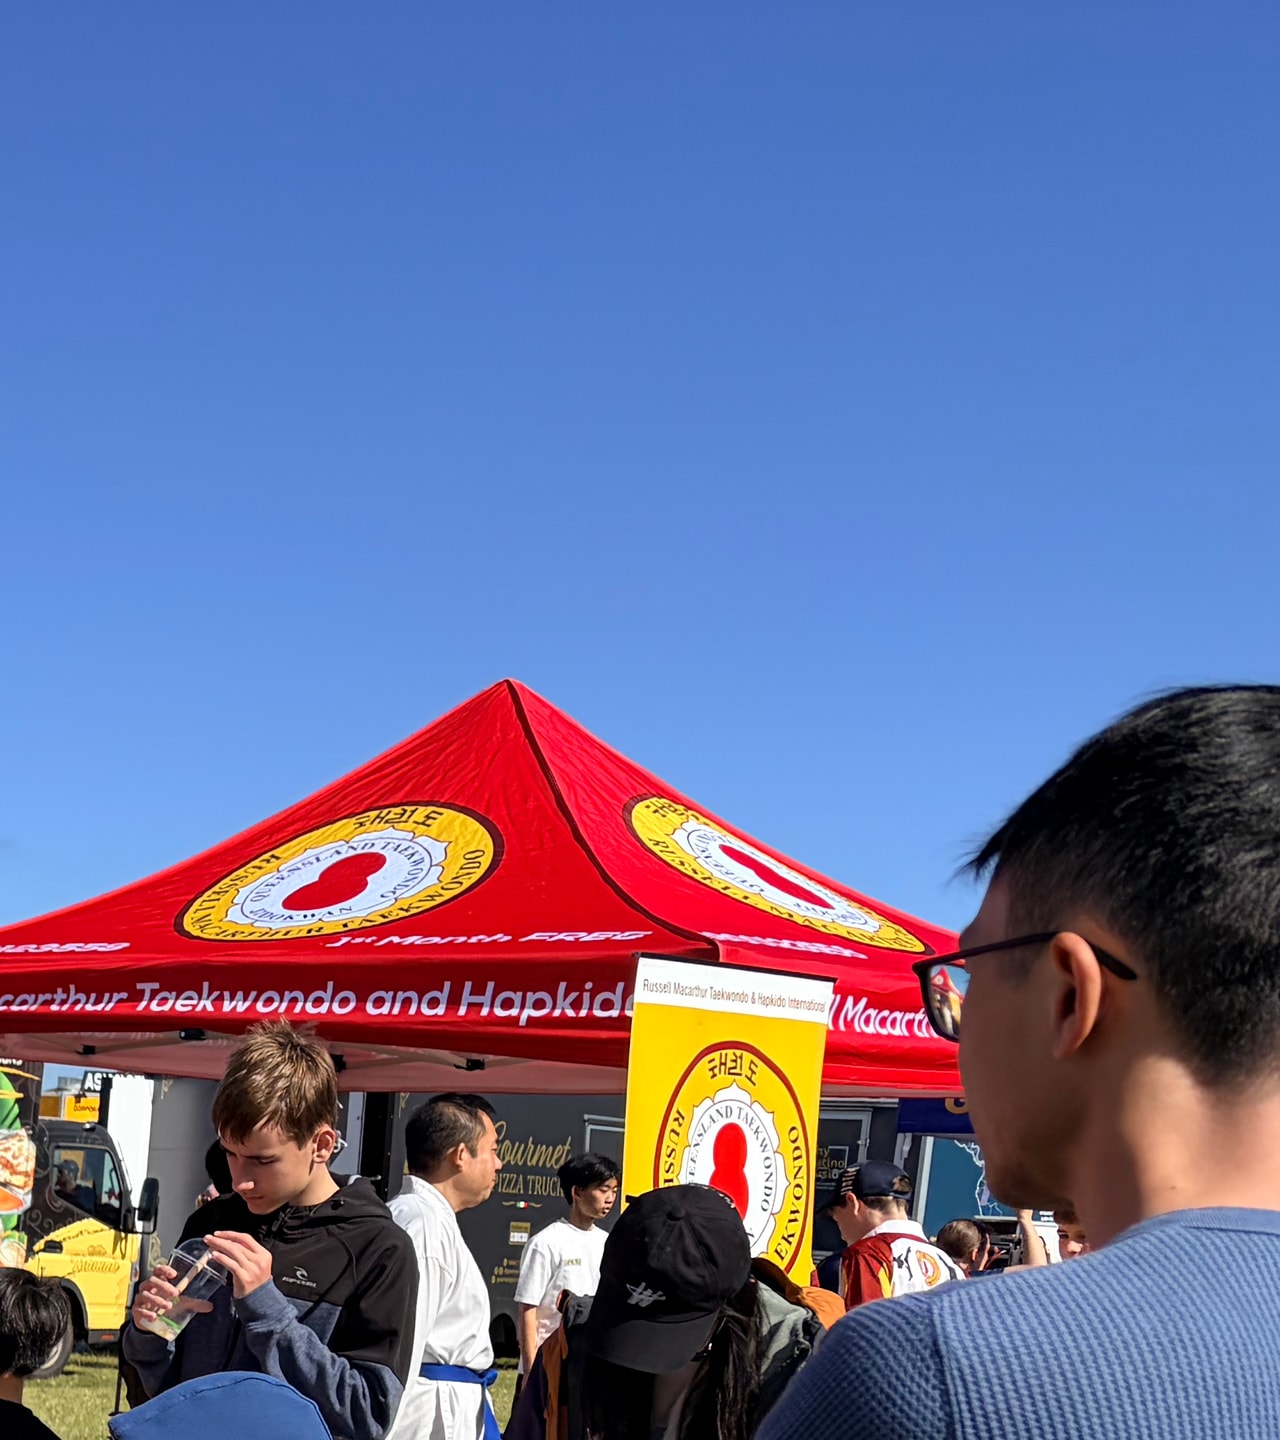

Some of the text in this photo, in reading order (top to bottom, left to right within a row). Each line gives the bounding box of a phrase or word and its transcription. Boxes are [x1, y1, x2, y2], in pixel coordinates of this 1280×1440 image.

[135, 981, 357, 1015] Taekwondo
[365, 981, 447, 1016] and
[642, 978, 827, 1013] Russell Macarthur Taekwondo & Hapkido International
[687, 1104, 734, 1181] EENSLAND
[736, 1106, 774, 1214] TAEKWONDO
[496, 1173, 524, 1195] IZZA
[774, 1125, 805, 1262] EKWONDO
